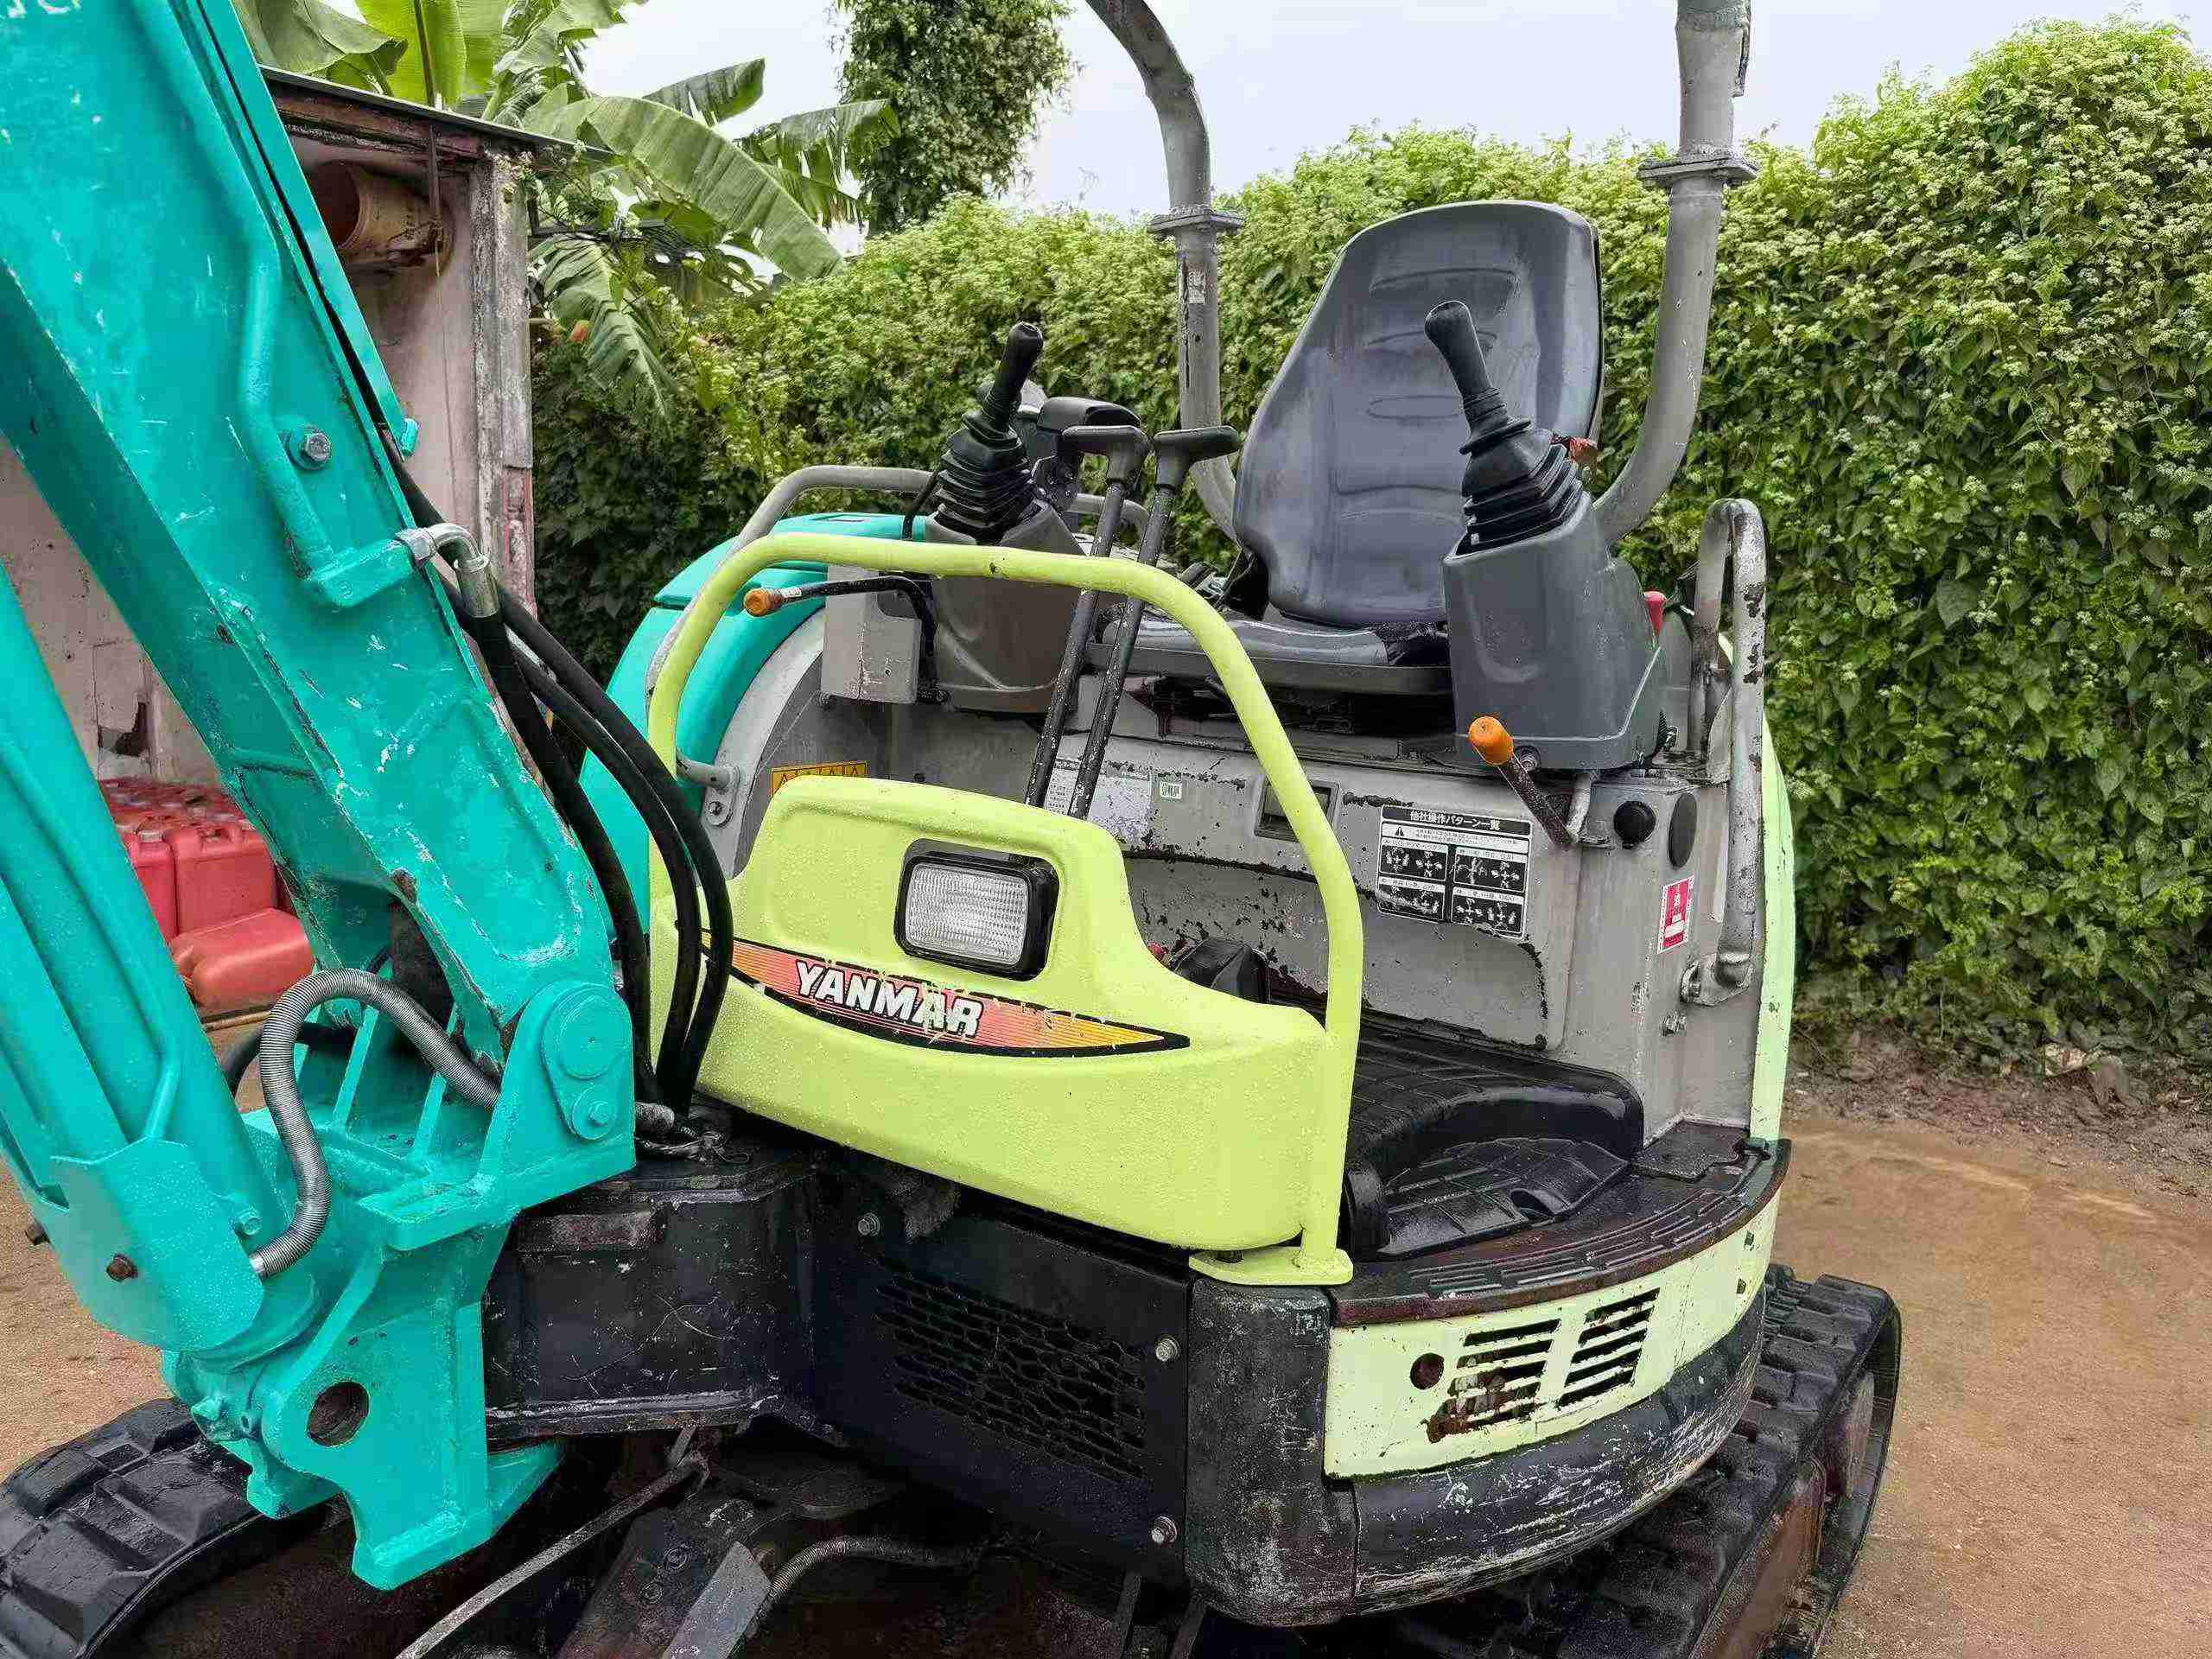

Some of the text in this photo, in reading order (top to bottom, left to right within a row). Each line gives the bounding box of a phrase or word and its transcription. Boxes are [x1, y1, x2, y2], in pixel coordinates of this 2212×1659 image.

[1410, 810, 1501, 830] 他社操作パターン一覧
[796, 959, 983, 1039] YANMAR
